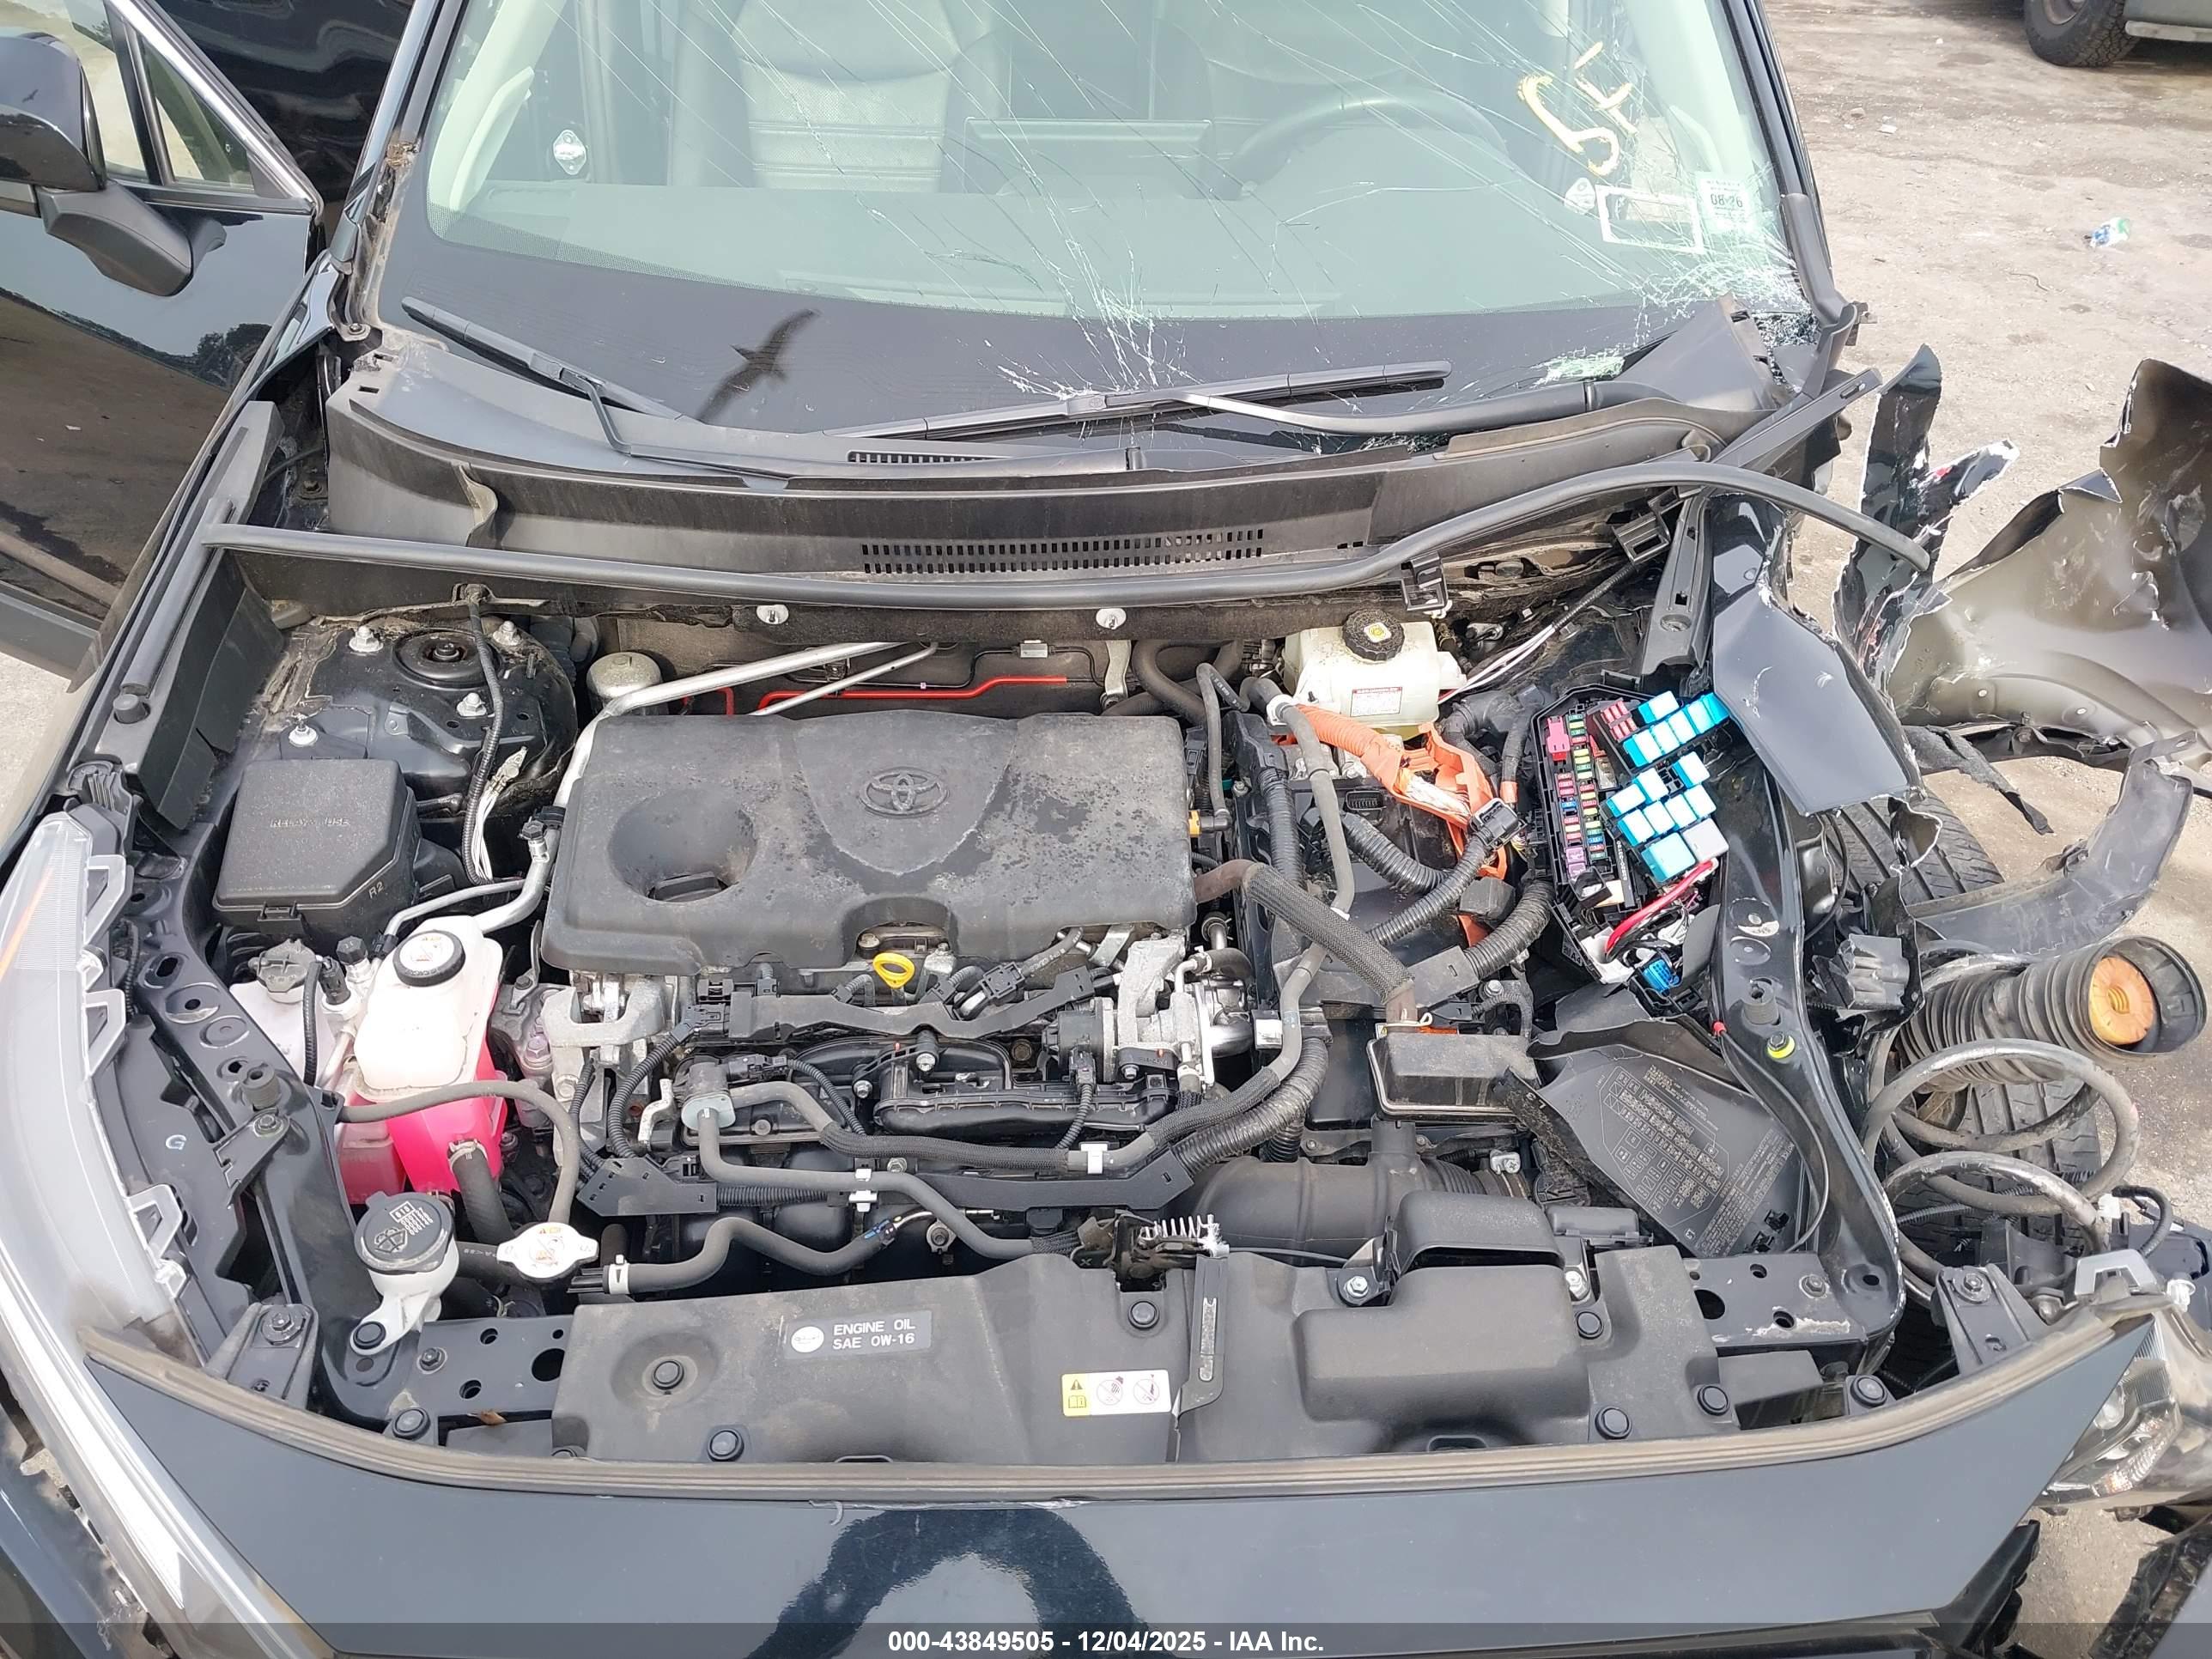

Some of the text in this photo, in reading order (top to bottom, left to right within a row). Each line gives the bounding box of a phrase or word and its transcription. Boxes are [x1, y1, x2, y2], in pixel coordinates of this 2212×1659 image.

[368, 881, 384, 899] R2
[833, 1318, 916, 1335] ENGINE OIL
[832, 1336, 862, 1350] SAE
